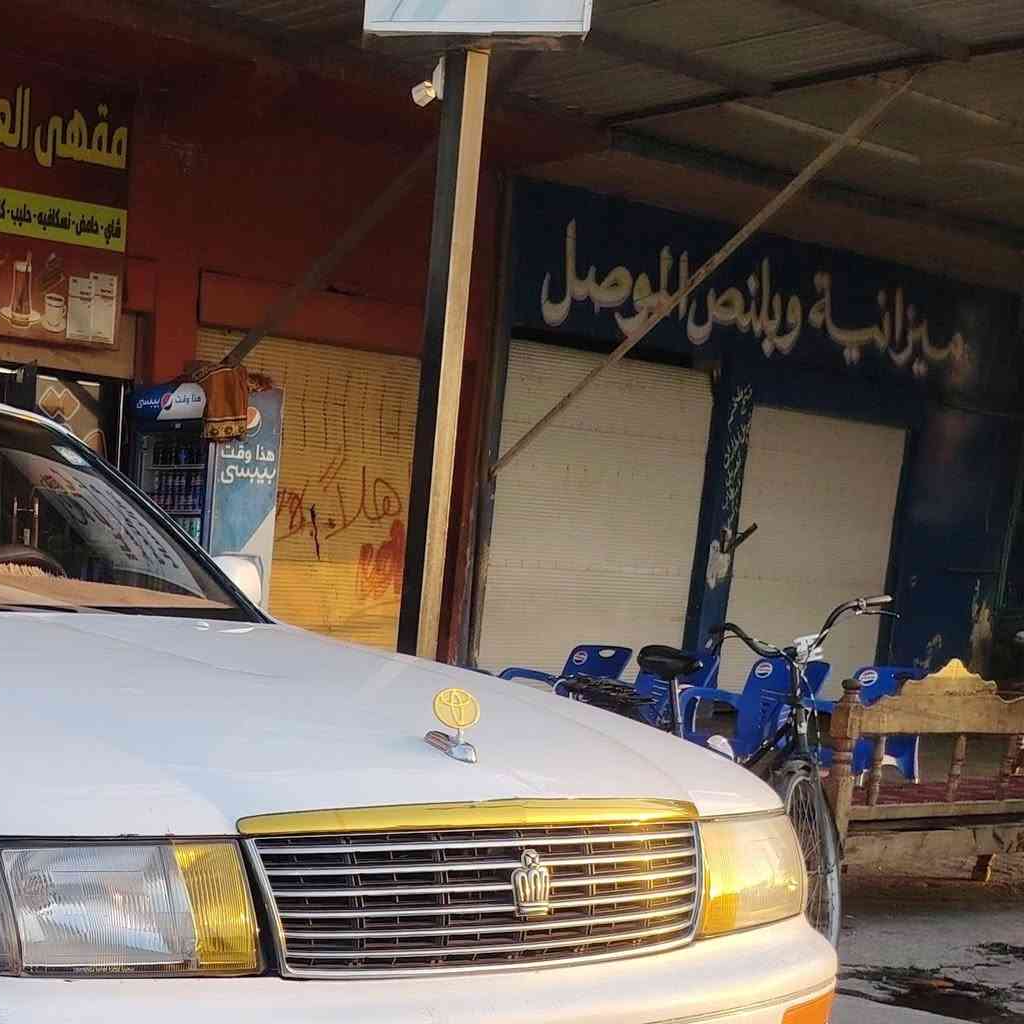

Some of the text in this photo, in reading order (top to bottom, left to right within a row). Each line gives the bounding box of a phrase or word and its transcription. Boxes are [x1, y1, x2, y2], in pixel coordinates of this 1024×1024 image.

[33, 102, 128, 170] مقهى
[221, 444, 275, 464] هذا وقت
